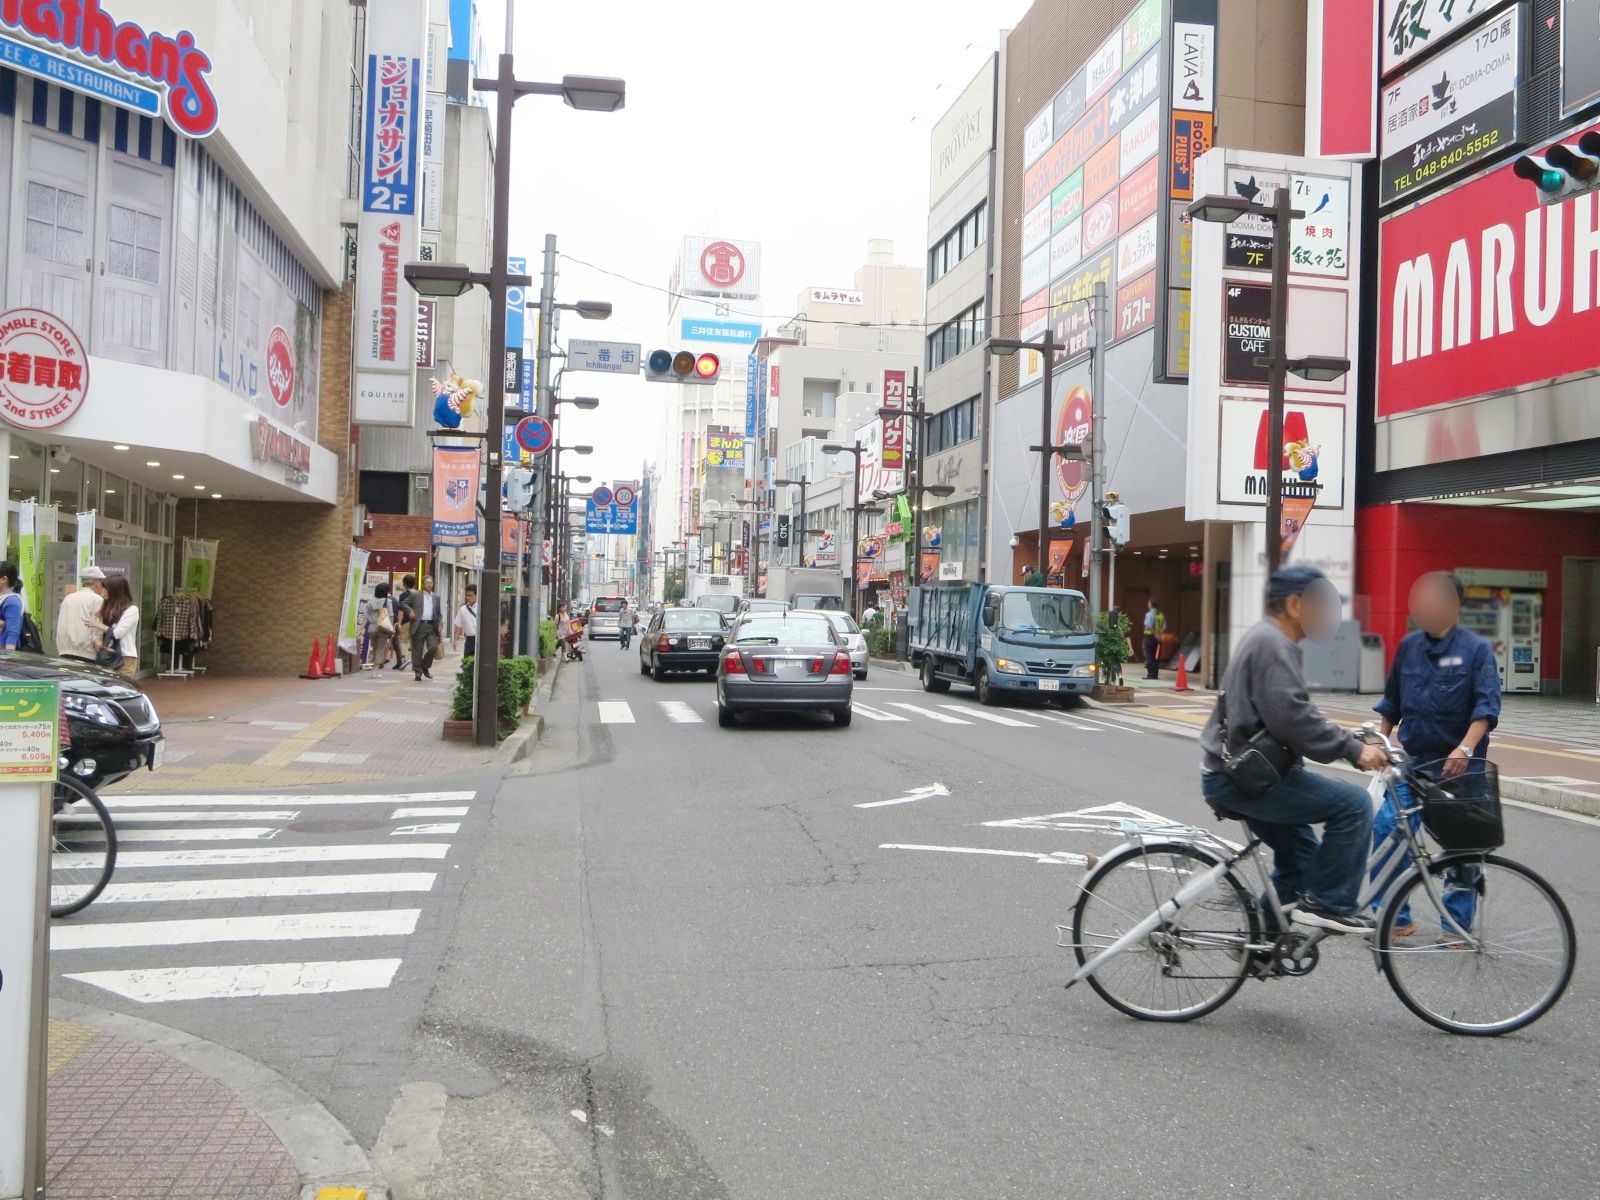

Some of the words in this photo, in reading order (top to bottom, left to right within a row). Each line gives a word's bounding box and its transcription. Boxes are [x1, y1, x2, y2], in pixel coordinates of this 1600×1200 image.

[0, 0, 217, 133] athan's
[1184, 33, 1199, 78] LAVA
[29, 54, 40, 70] &
[47, 60, 141, 104] RESTAURANT
[376, 60, 408, 178] ジョナサン
[938, 104, 982, 176] PROVOST
[1394, 174, 1412, 192] TEL
[1415, 130, 1499, 181] 048-640-5552
[370, 187, 408, 211] 2F
[1295, 180, 1311, 196] 7F
[1305, 225, 1333, 239] 焼肉
[1247, 252, 1264, 266] 7F
[1291, 246, 1345, 269] 叙々苑
[379, 243, 399, 306] JUMBLE
[1228, 288, 1241, 297] 4F
[1121, 297, 1151, 332] ガスト
[40, 321, 75, 358] STORE
[379, 307, 397, 361] STORE
[691, 326, 752, 339] 三井住友信託銀行
[1229, 324, 1270, 339] CUSTOM
[575, 348, 634, 364] 一番街
[1241, 340, 1265, 353] CAFE
[237, 353, 258, 396] 入口
[585, 361, 622, 371] Ichibangai
[3, 400, 26, 418] 2nd
[29, 393, 73, 420] STREET
[361, 390, 405, 399] EQUINIA
[710, 436, 744, 449] まんが
